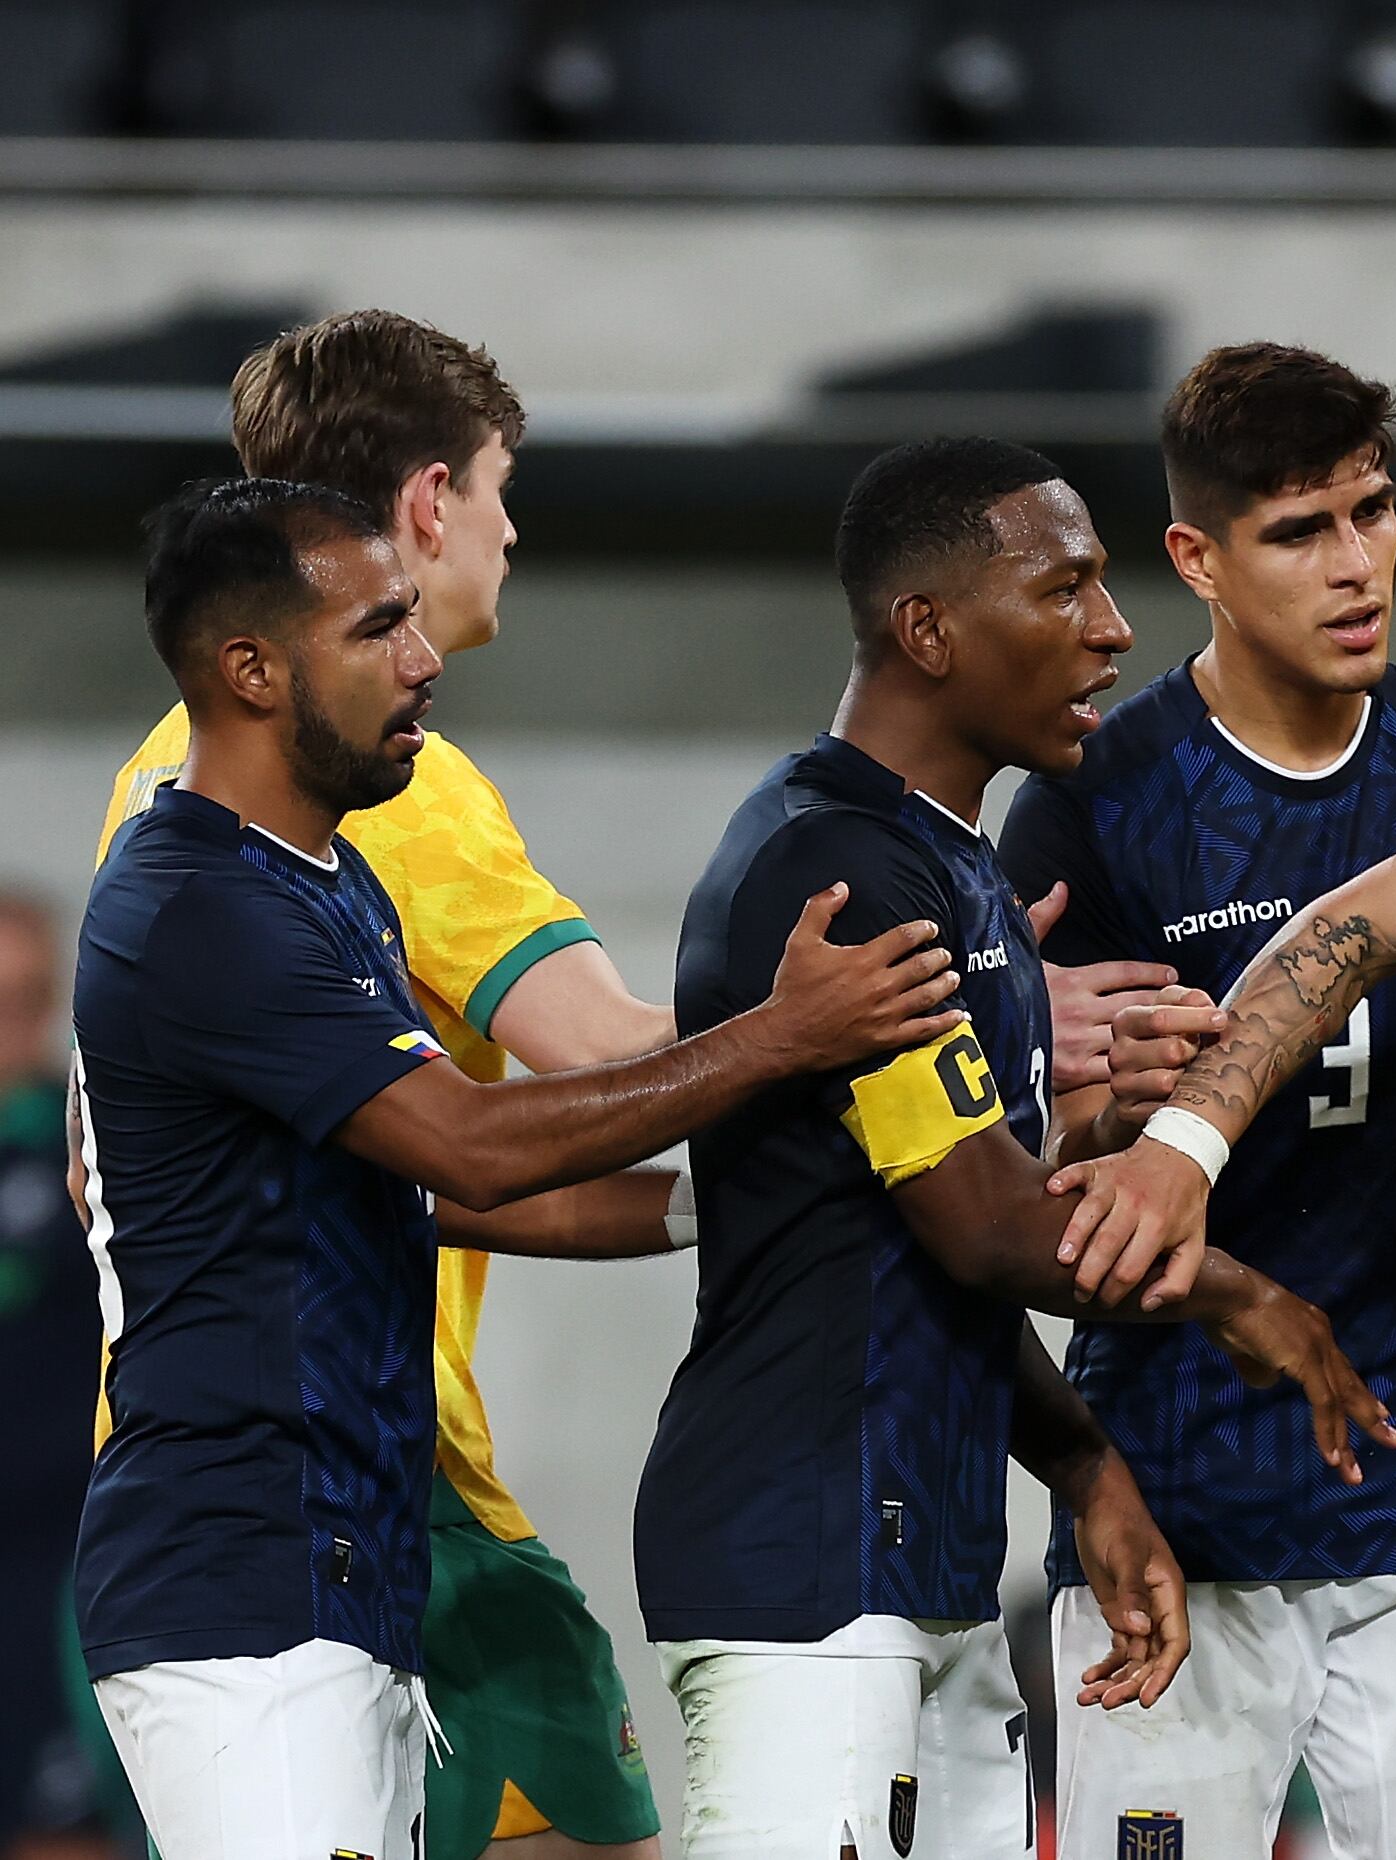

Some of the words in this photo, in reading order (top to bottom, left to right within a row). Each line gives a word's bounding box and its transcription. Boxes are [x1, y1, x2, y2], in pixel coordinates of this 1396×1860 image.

[1163, 898, 1293, 943] marathon
[933, 1033, 997, 1119] C
[1308, 996, 1371, 1129] 3
